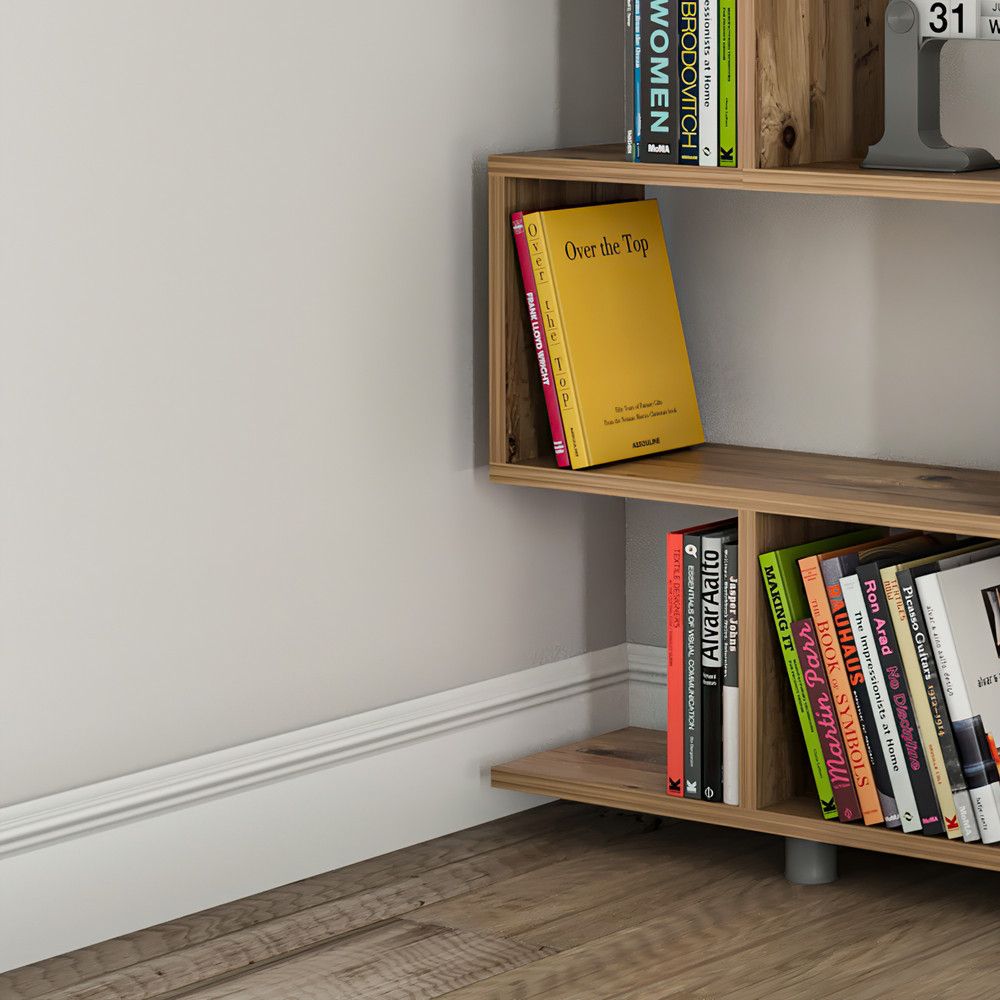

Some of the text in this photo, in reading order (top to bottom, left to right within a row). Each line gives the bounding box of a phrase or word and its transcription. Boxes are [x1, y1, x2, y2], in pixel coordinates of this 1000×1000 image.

[928, 2, 965, 34] 31
[680, 1, 698, 148] BRODOVITCH
[703, 75, 712, 107] Home
[704, 60, 711, 71] at
[647, 143, 671, 154] MoMA
[564, 233, 649, 261] Over the Top
[526, 291, 550, 386] FRANK LLOYD WRIGHT
[673, 549, 681, 629] TEXTILE DESIGNERS
[728, 576, 738, 652] Jasper Johns
[764, 565, 795, 652] MAKING IT
[854, 611, 864, 632] The
[687, 565, 695, 731] ESSENTIALS OF VISUAL COMMUNICATION
[799, 622, 825, 688] Parr
[826, 583, 865, 687] BAUHAUS
[902, 585, 932, 681] Picasso Guitars
[811, 598, 820, 618] THE
[817, 620, 840, 674] BOOK
[835, 693, 870, 788] SYMBOLS
[860, 635, 887, 720] Impressionists
[864, 579, 921, 771] Ron Arad No Discipline
[977, 675, 993, 688] alvar
[815, 692, 850, 790] Martin
[882, 723, 891, 735] at
[886, 738, 899, 772] Home
[958, 805, 972, 836] MoMA
